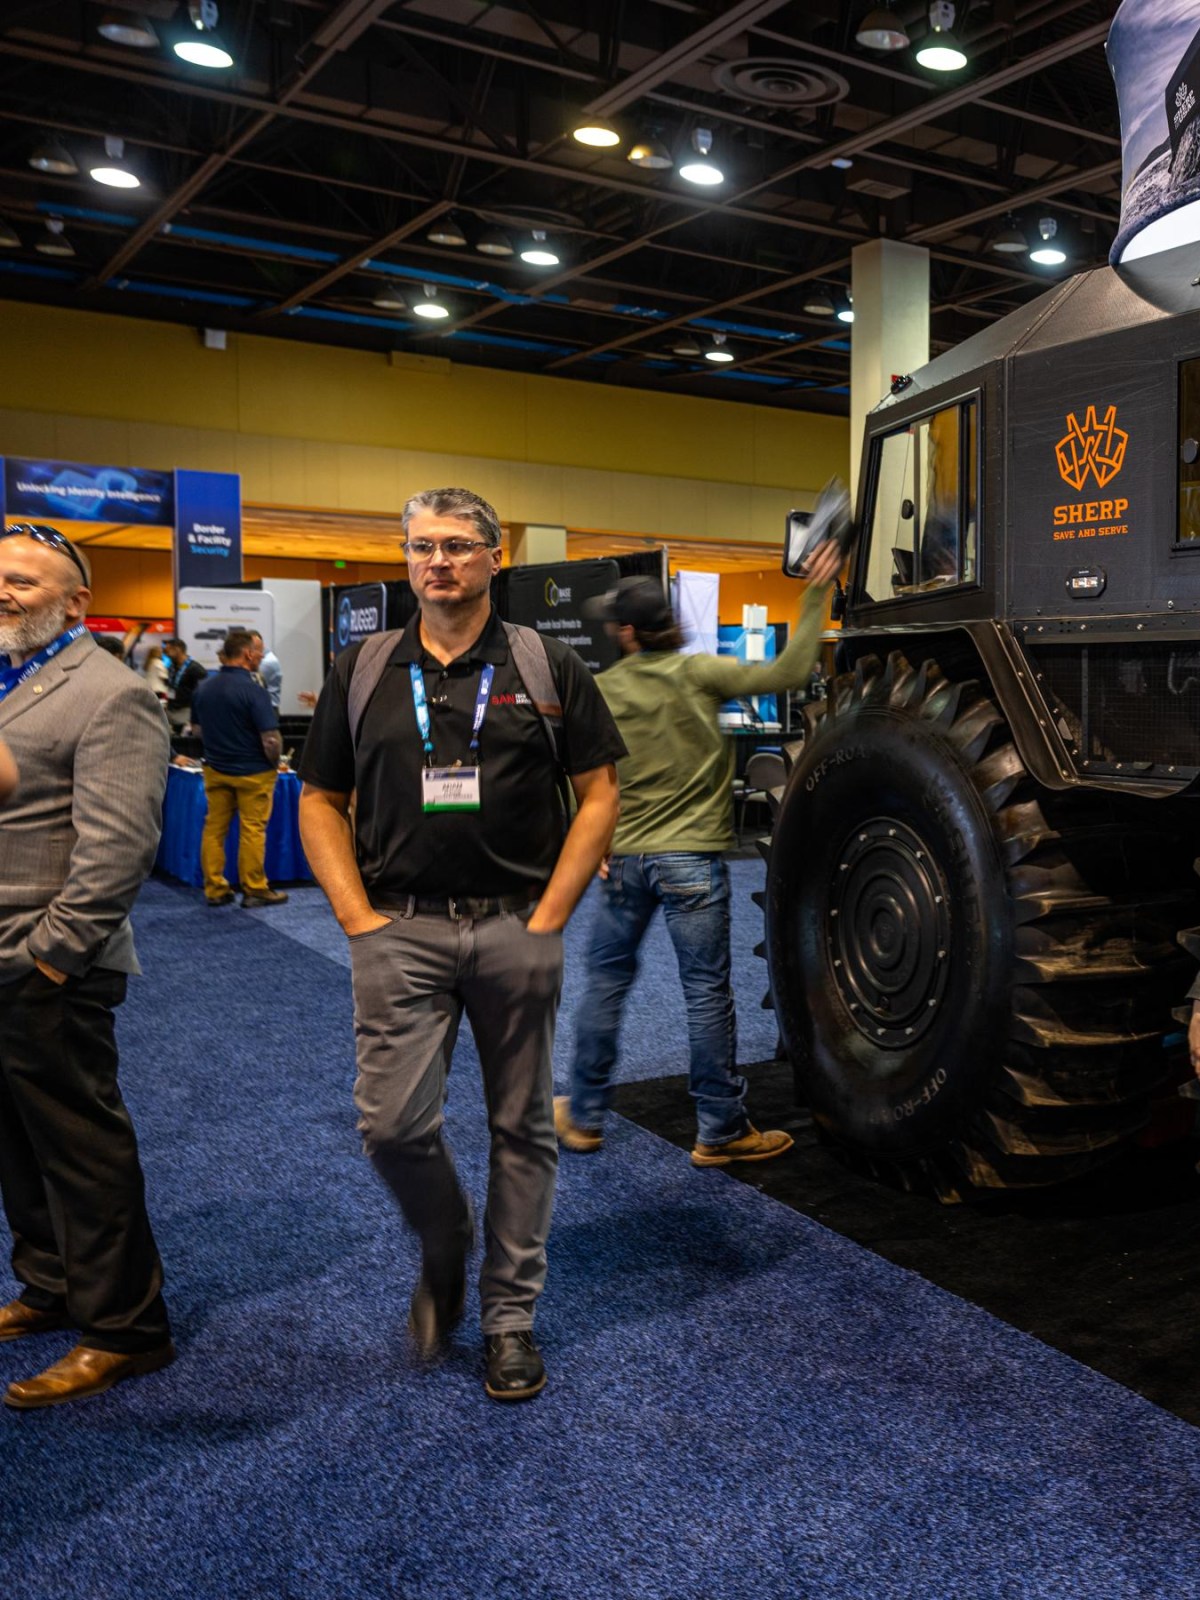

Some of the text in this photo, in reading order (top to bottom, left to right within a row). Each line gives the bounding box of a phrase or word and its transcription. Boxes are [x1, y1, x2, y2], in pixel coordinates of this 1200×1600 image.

[16, 481, 161, 503] Unlocking Identity Intelligence
[1053, 498, 1129, 525] SHERP
[192, 523, 226, 535] Border
[1053, 524, 1129, 540] SAVE AND SERVE
[197, 534, 232, 547] Facility
[190, 544, 230, 558] Security
[350, 607, 378, 632] RUGGED
